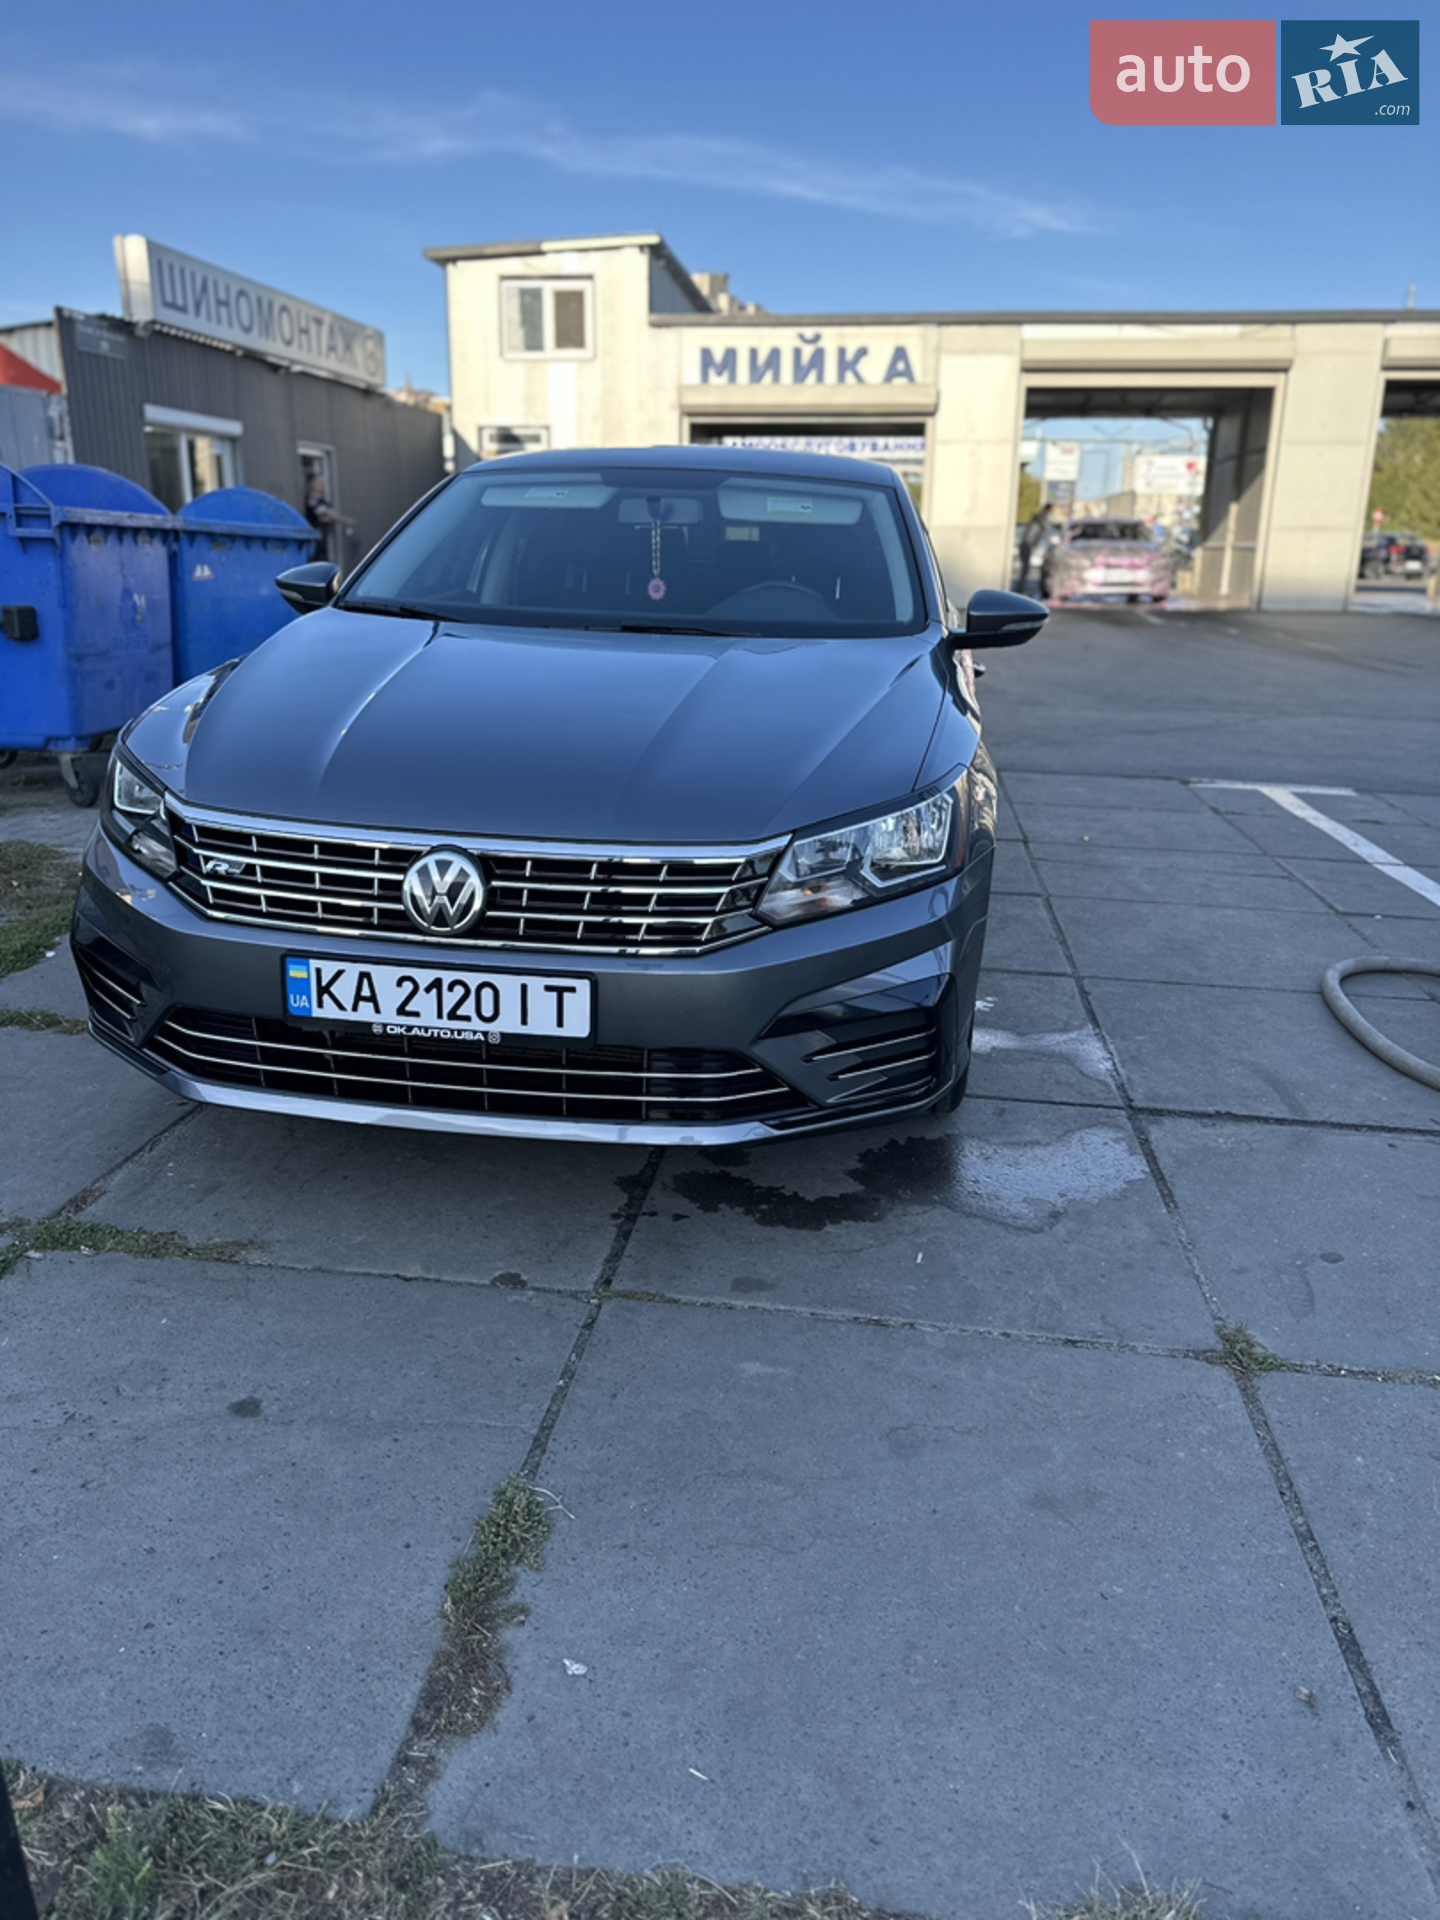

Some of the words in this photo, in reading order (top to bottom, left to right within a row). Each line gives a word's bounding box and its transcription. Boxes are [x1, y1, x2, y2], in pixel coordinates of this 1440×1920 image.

[156, 258, 359, 369] ШИНОМОНТАЖ
[700, 333, 916, 385] МИЙКА
[289, 993, 310, 1009] UA
[314, 966, 382, 1015] KA
[395, 975, 501, 1024] 2120
[519, 982, 577, 1029] IT
